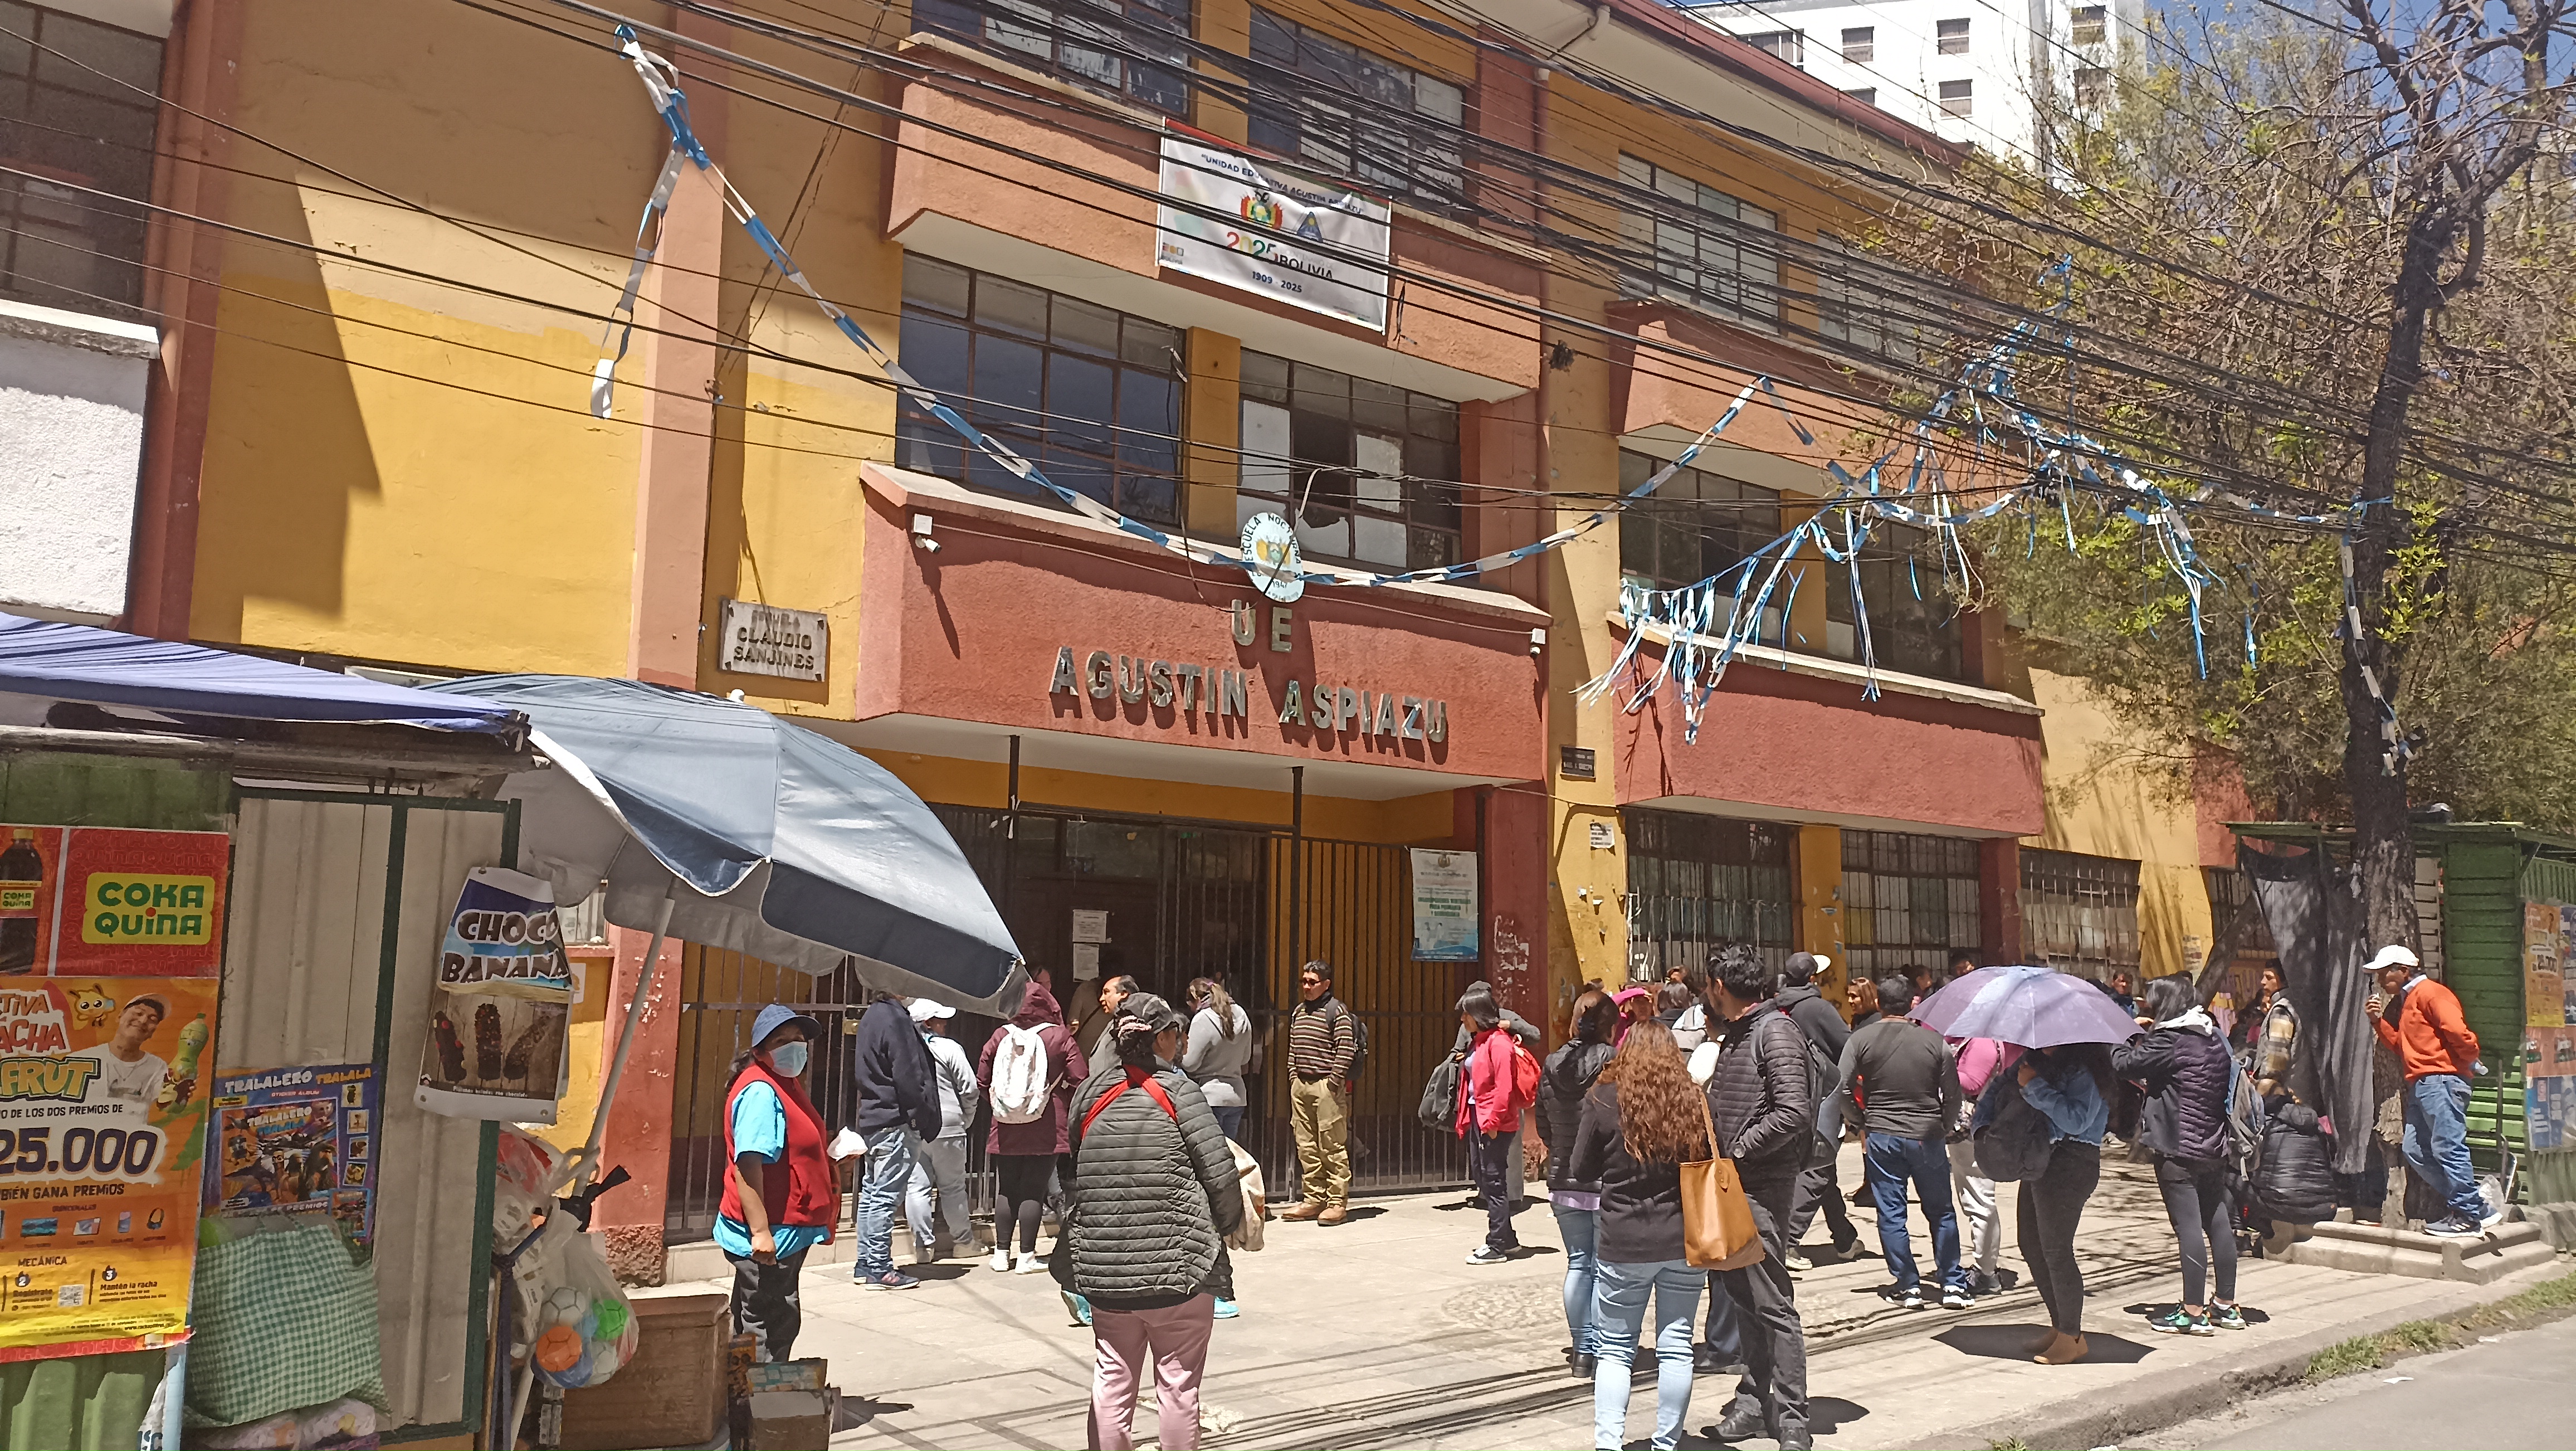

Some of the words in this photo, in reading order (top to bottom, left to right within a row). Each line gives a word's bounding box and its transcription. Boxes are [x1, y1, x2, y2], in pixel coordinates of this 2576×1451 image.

[1242, 167, 1289, 193] EDATIVA
[1227, 231, 1279, 264] 2025
[1280, 254, 1333, 280] BOLIVIA
[1252, 271, 1273, 285] 1909
[1281, 280, 1302, 293] 2025
[1242, 516, 1262, 562] ESCUELA
[737, 627, 812, 651] CLAUDIO
[1231, 599, 1256, 646] U
[1271, 607, 1293, 654] E
[733, 645, 814, 670] SANJINES
[1049, 646, 1247, 718] AGUSTIN
[1279, 679, 1448, 743] ASPIAZU
[97, 882, 204, 908] COKA
[457, 910, 557, 944] CHOCO
[442, 951, 570, 983] BANANA
[315, 1067, 372, 1085] TRALALA
[10, 1109, 22, 1118] DE
[26, 1107, 44, 1118] LOS
[47, 1107, 66, 1117] DOS
[112, 1104, 124, 1113] DE
[0, 1127, 158, 1175] 25.000
[33, 1186, 69, 1199] GANA
[18, 1275, 26, 1287] 2
[106, 1270, 114, 1280] 3
